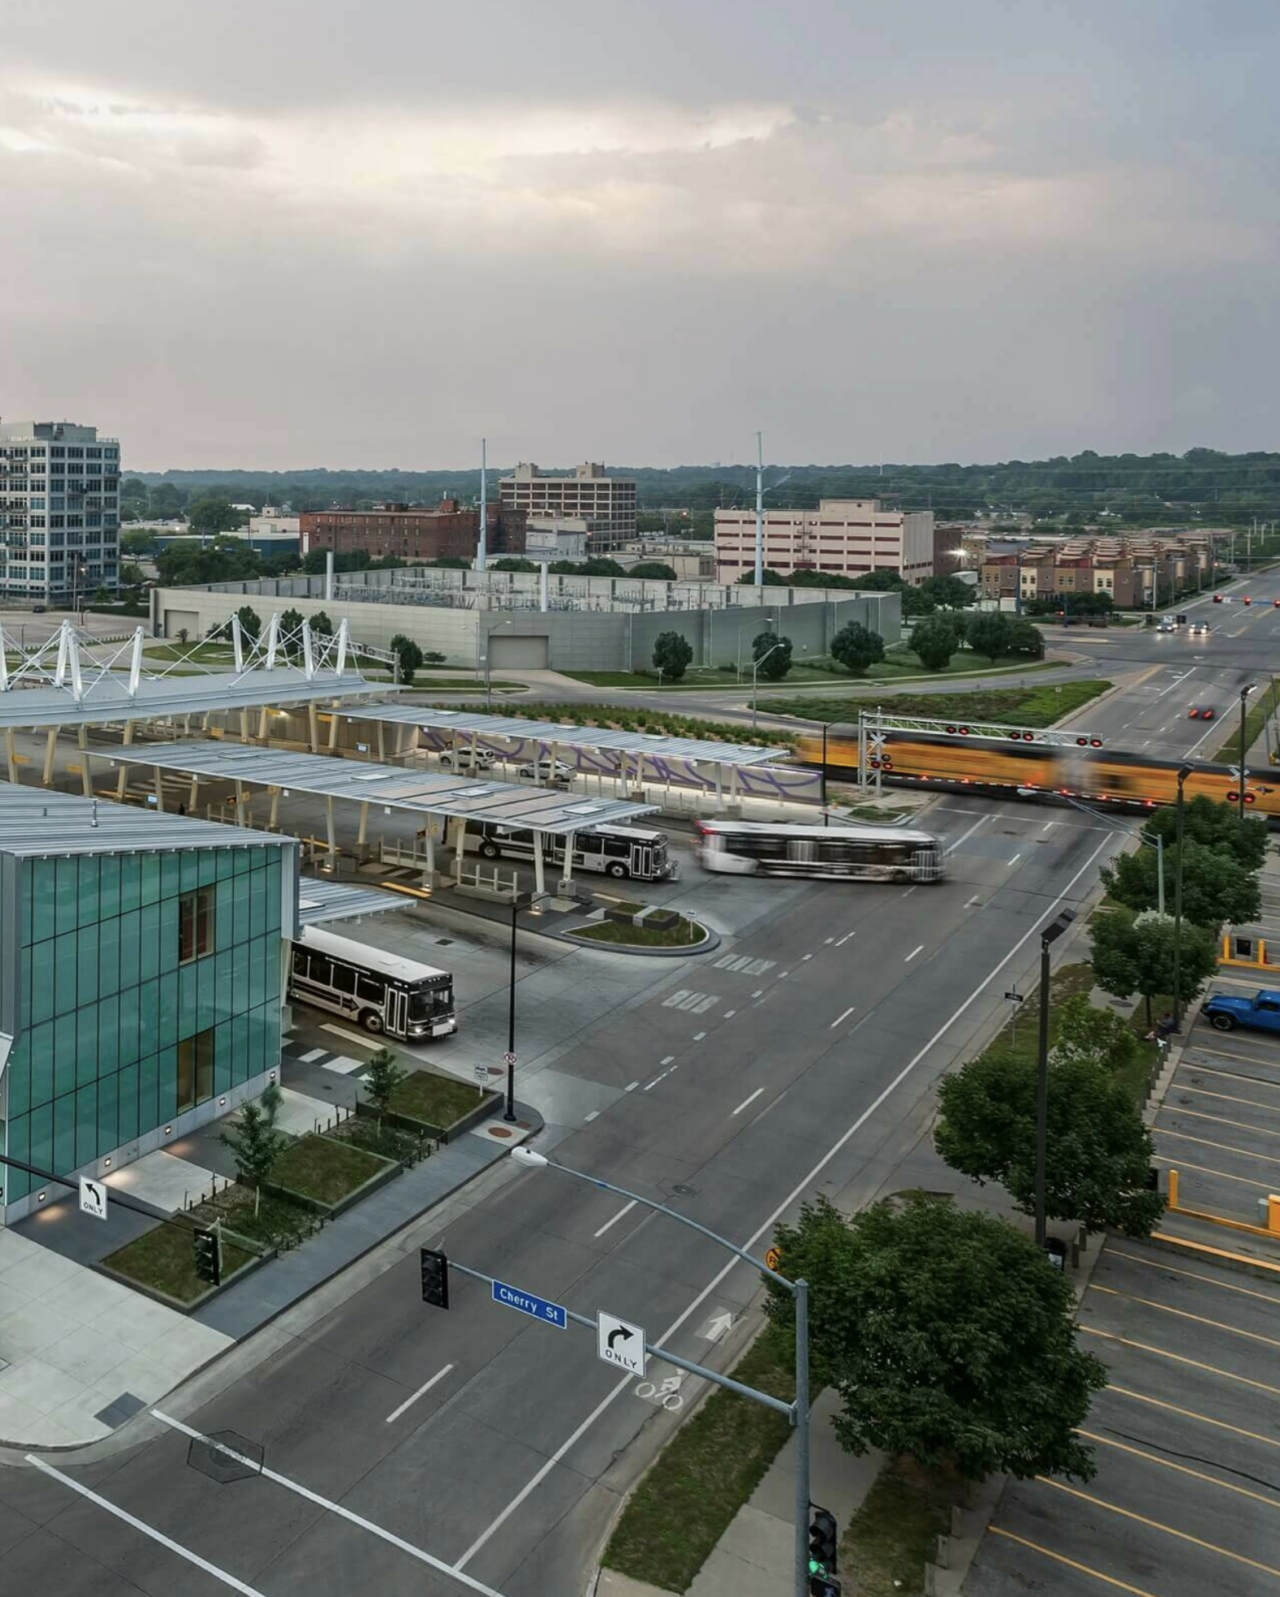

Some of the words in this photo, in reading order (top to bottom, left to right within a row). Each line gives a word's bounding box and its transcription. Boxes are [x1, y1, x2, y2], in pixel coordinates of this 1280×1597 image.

[83, 1201, 103, 1215] ONLY
[500, 1288, 537, 1313] Cherry
[546, 1306, 558, 1321] St
[605, 1349, 637, 1368] ONLY
